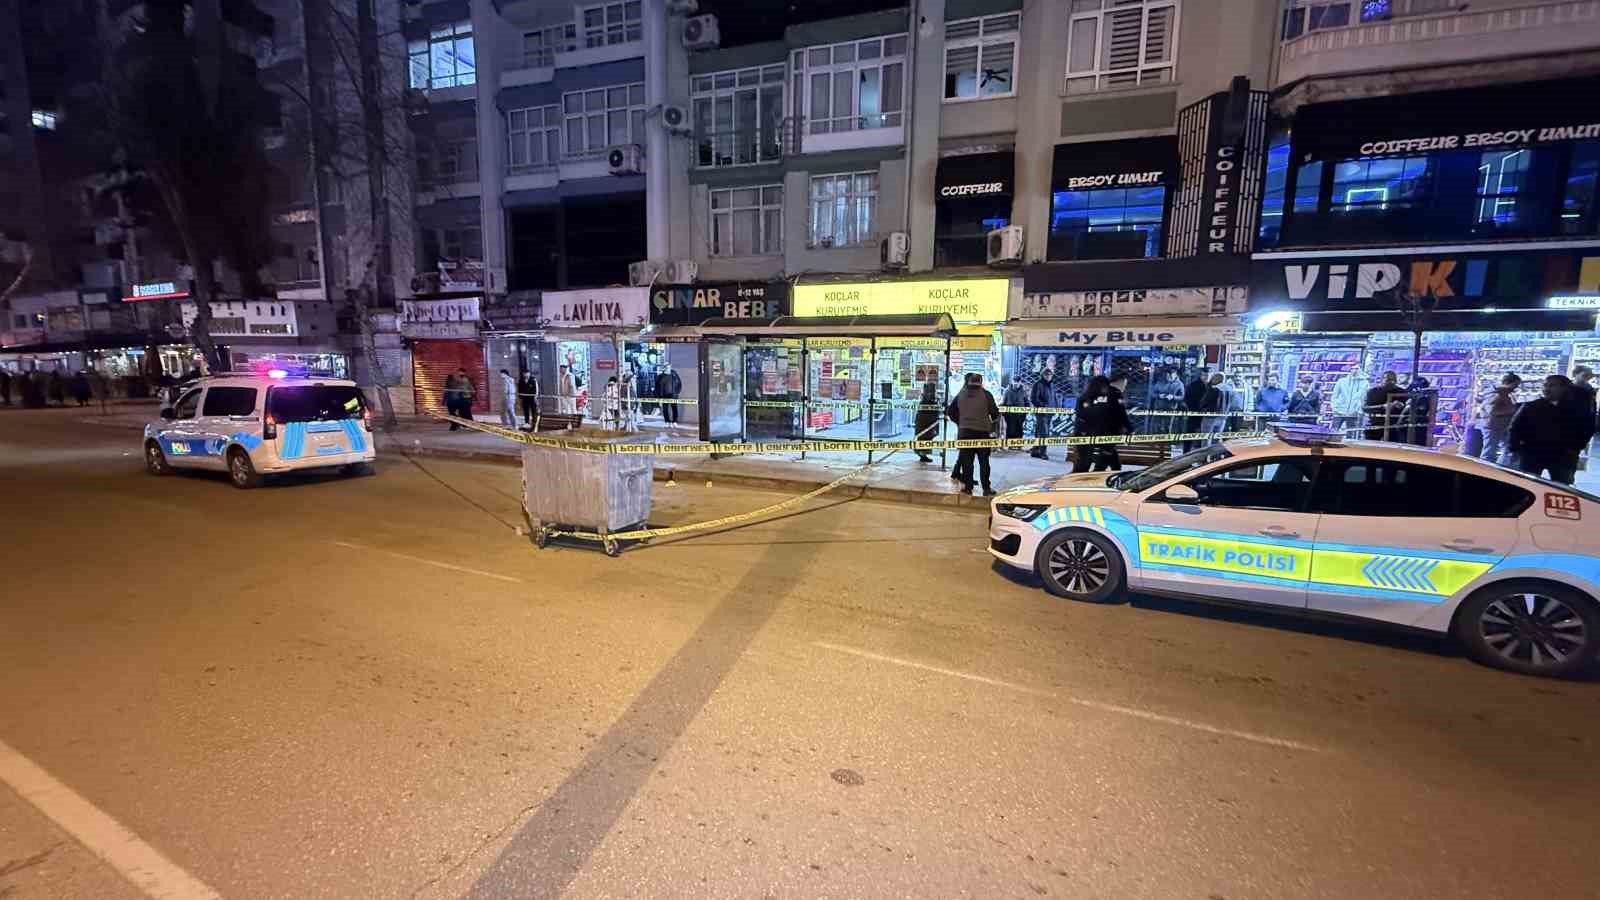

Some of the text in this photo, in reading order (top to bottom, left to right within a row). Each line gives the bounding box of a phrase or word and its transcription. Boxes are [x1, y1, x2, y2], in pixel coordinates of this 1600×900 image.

[1360, 123, 1600, 155] COIFFEUR ERSOY UMUT
[941, 182, 1003, 196] COIFFEUR
[1068, 171, 1163, 188] ERSOY UMUT
[1208, 146, 1235, 253] COIFFEUR
[653, 288, 721, 314] ÇINAR
[928, 287, 969, 301] KOÇLAR
[562, 299, 623, 321] LAVİNYA
[723, 300, 779, 319] BEBE
[1058, 330, 1175, 345] My Blue
[1548, 495, 1577, 509] 112
[1147, 542, 1296, 572] TRAFİK POLİSİ
